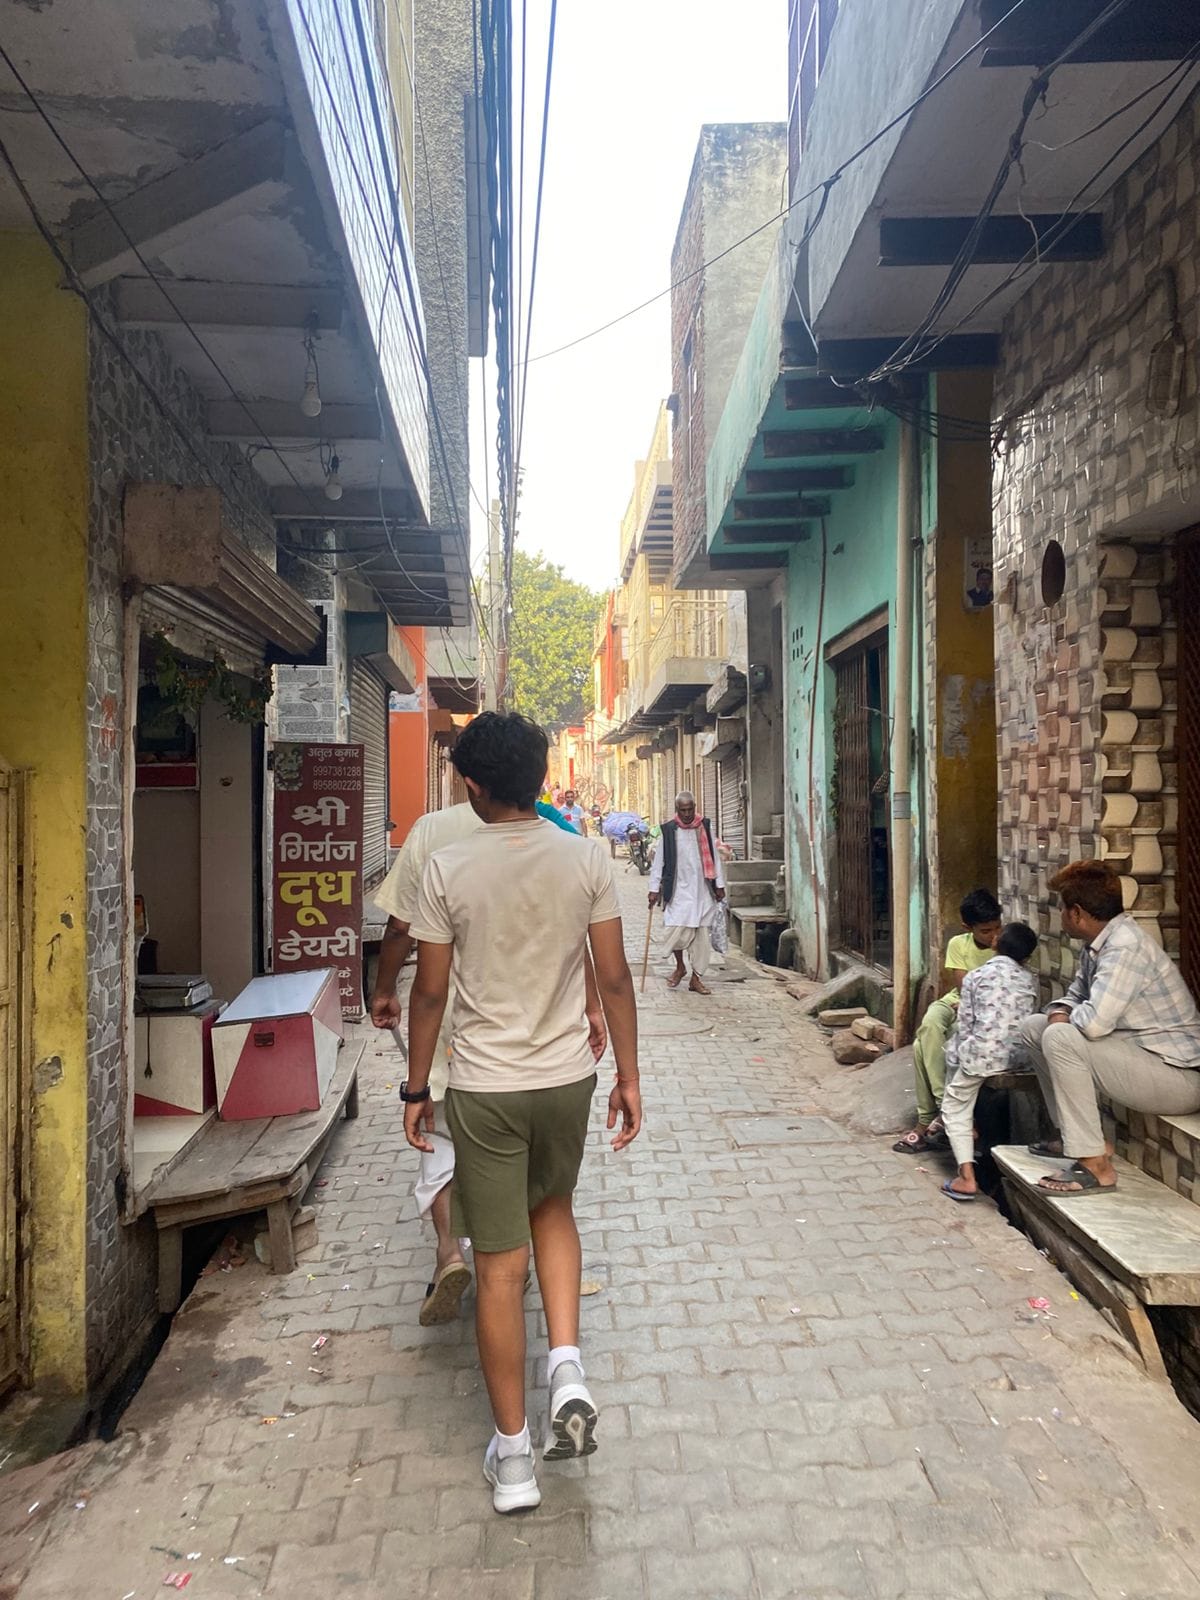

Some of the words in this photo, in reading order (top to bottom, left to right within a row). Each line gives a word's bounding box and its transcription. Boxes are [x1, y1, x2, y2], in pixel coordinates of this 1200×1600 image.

[307, 748, 334, 762] अतुल
[334, 748, 360, 762] कुमार
[291, 796, 350, 826] श्री
[278, 832, 358, 862] गिर्राज
[278, 871, 357, 927] दूध
[277, 926, 359, 961] डेयरी
